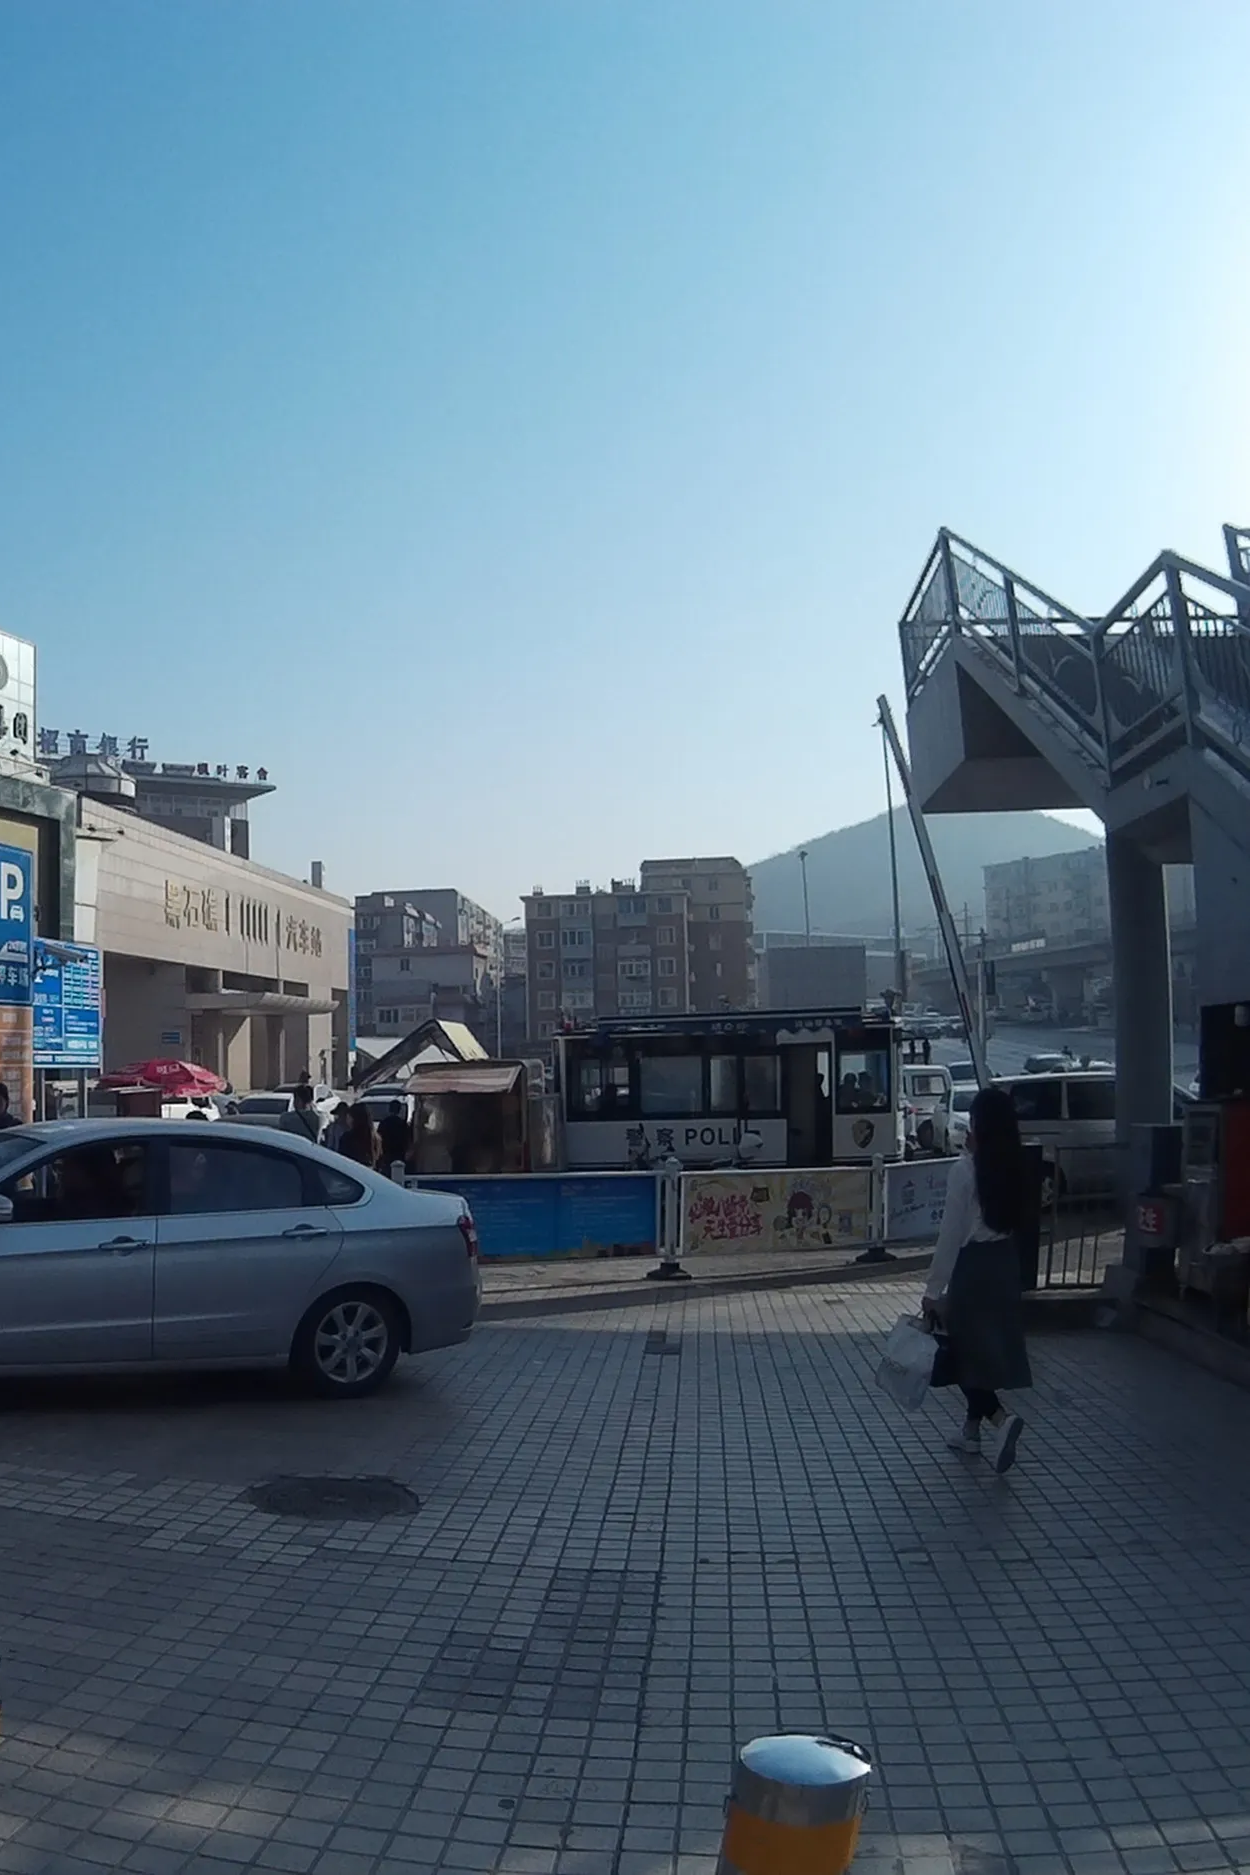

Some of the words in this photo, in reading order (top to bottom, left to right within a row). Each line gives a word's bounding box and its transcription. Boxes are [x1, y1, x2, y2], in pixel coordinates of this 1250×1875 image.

[37, 727, 150, 761] 招商银行
[685, 1127, 762, 1147] POLI
